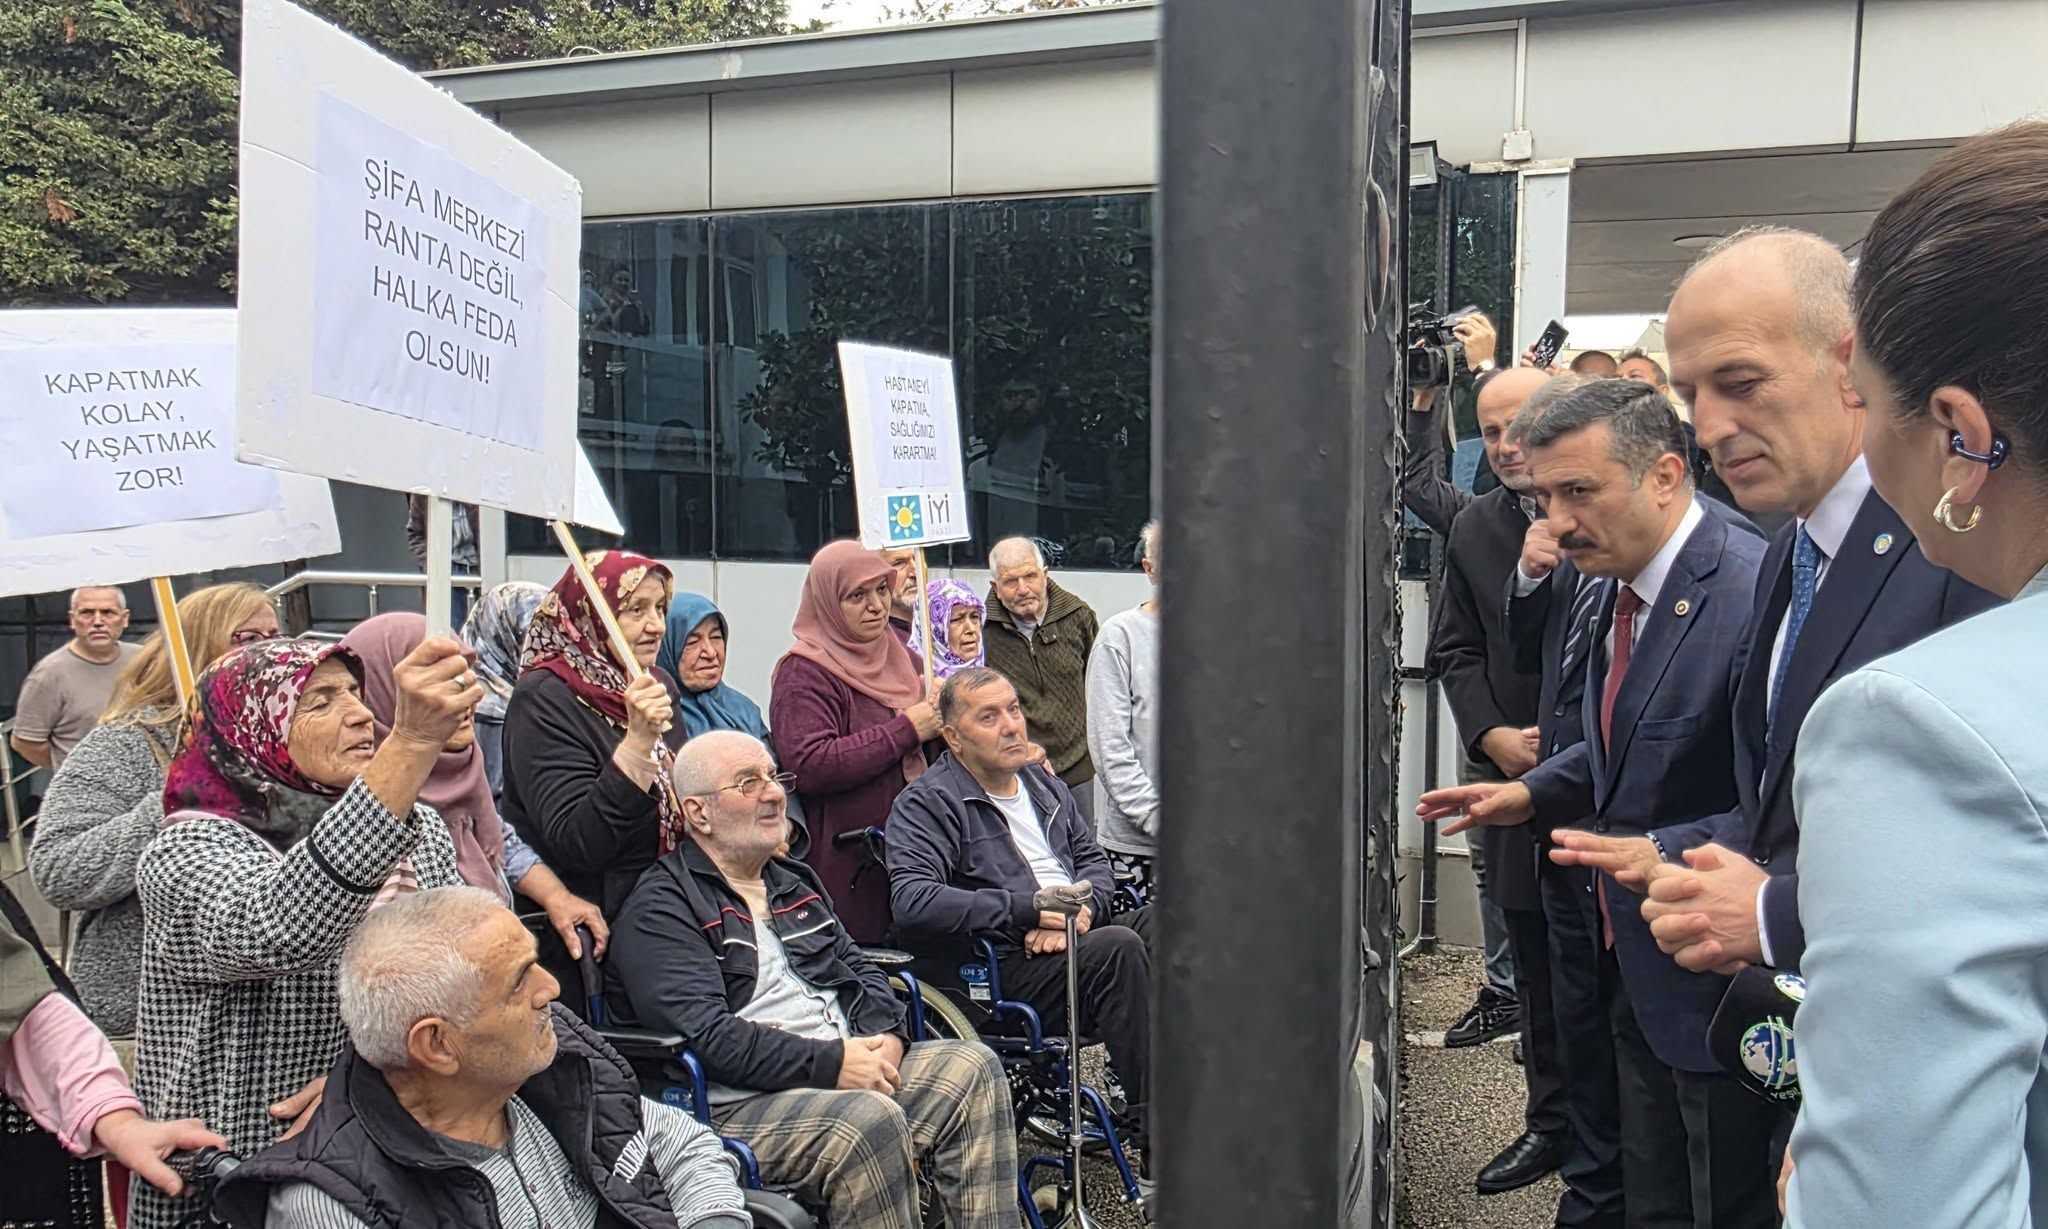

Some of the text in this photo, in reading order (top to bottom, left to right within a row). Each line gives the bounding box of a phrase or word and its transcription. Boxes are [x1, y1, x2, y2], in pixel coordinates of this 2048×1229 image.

[364, 158, 525, 262] ŞİFA MERKEZİ
[365, 209, 523, 310] RANTA DEĞİL,
[373, 265, 518, 348] HALKA FEDA
[406, 330, 490, 384] OLSUN!
[44, 368, 203, 394] KAPATMAK
[884, 376, 930, 394] HASTANEYİ
[80, 400, 185, 426] KOLAY,
[890, 399, 931, 418] KAPATMA,
[61, 429, 216, 463] YAŞATMAK
[892, 445, 937, 461] KARARTMA!
[115, 466, 184, 492] ZOR!
[927, 493, 950, 525] İYİ
